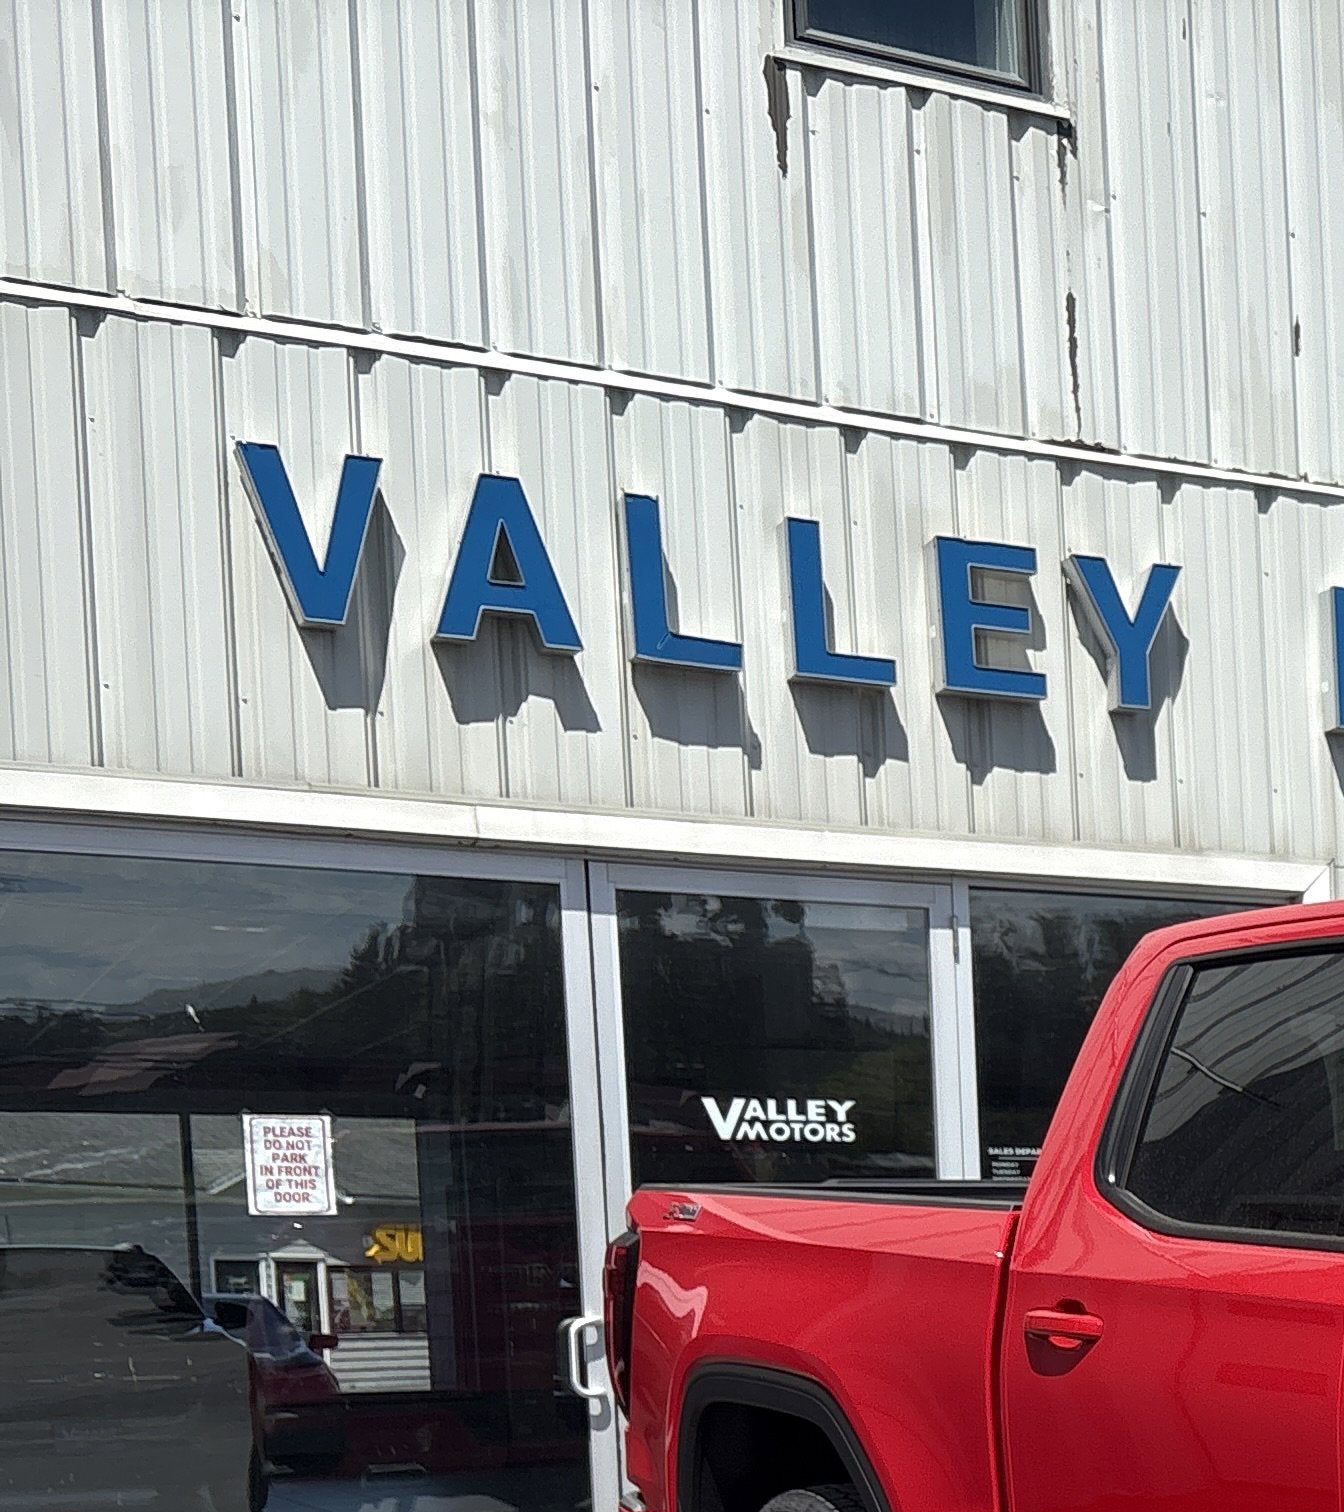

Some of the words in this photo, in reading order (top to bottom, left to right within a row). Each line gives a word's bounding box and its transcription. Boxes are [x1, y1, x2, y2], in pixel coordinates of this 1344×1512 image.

[234, 440, 1182, 712] VALLEY
[700, 1096, 856, 1140] VALLEY
[263, 1126, 312, 1138] PLEASE
[735, 1121, 856, 1142] MOTORS
[264, 1139, 282, 1151] DO
[286, 1139, 312, 1151] NOT
[272, 1152, 308, 1163] PARK
[260, 1165, 273, 1177] IN
[277, 1165, 320, 1177] FRONT
[265, 1178, 282, 1190] OF
[287, 1178, 317, 1190] THIS
[274, 1191, 312, 1203] DOOR
